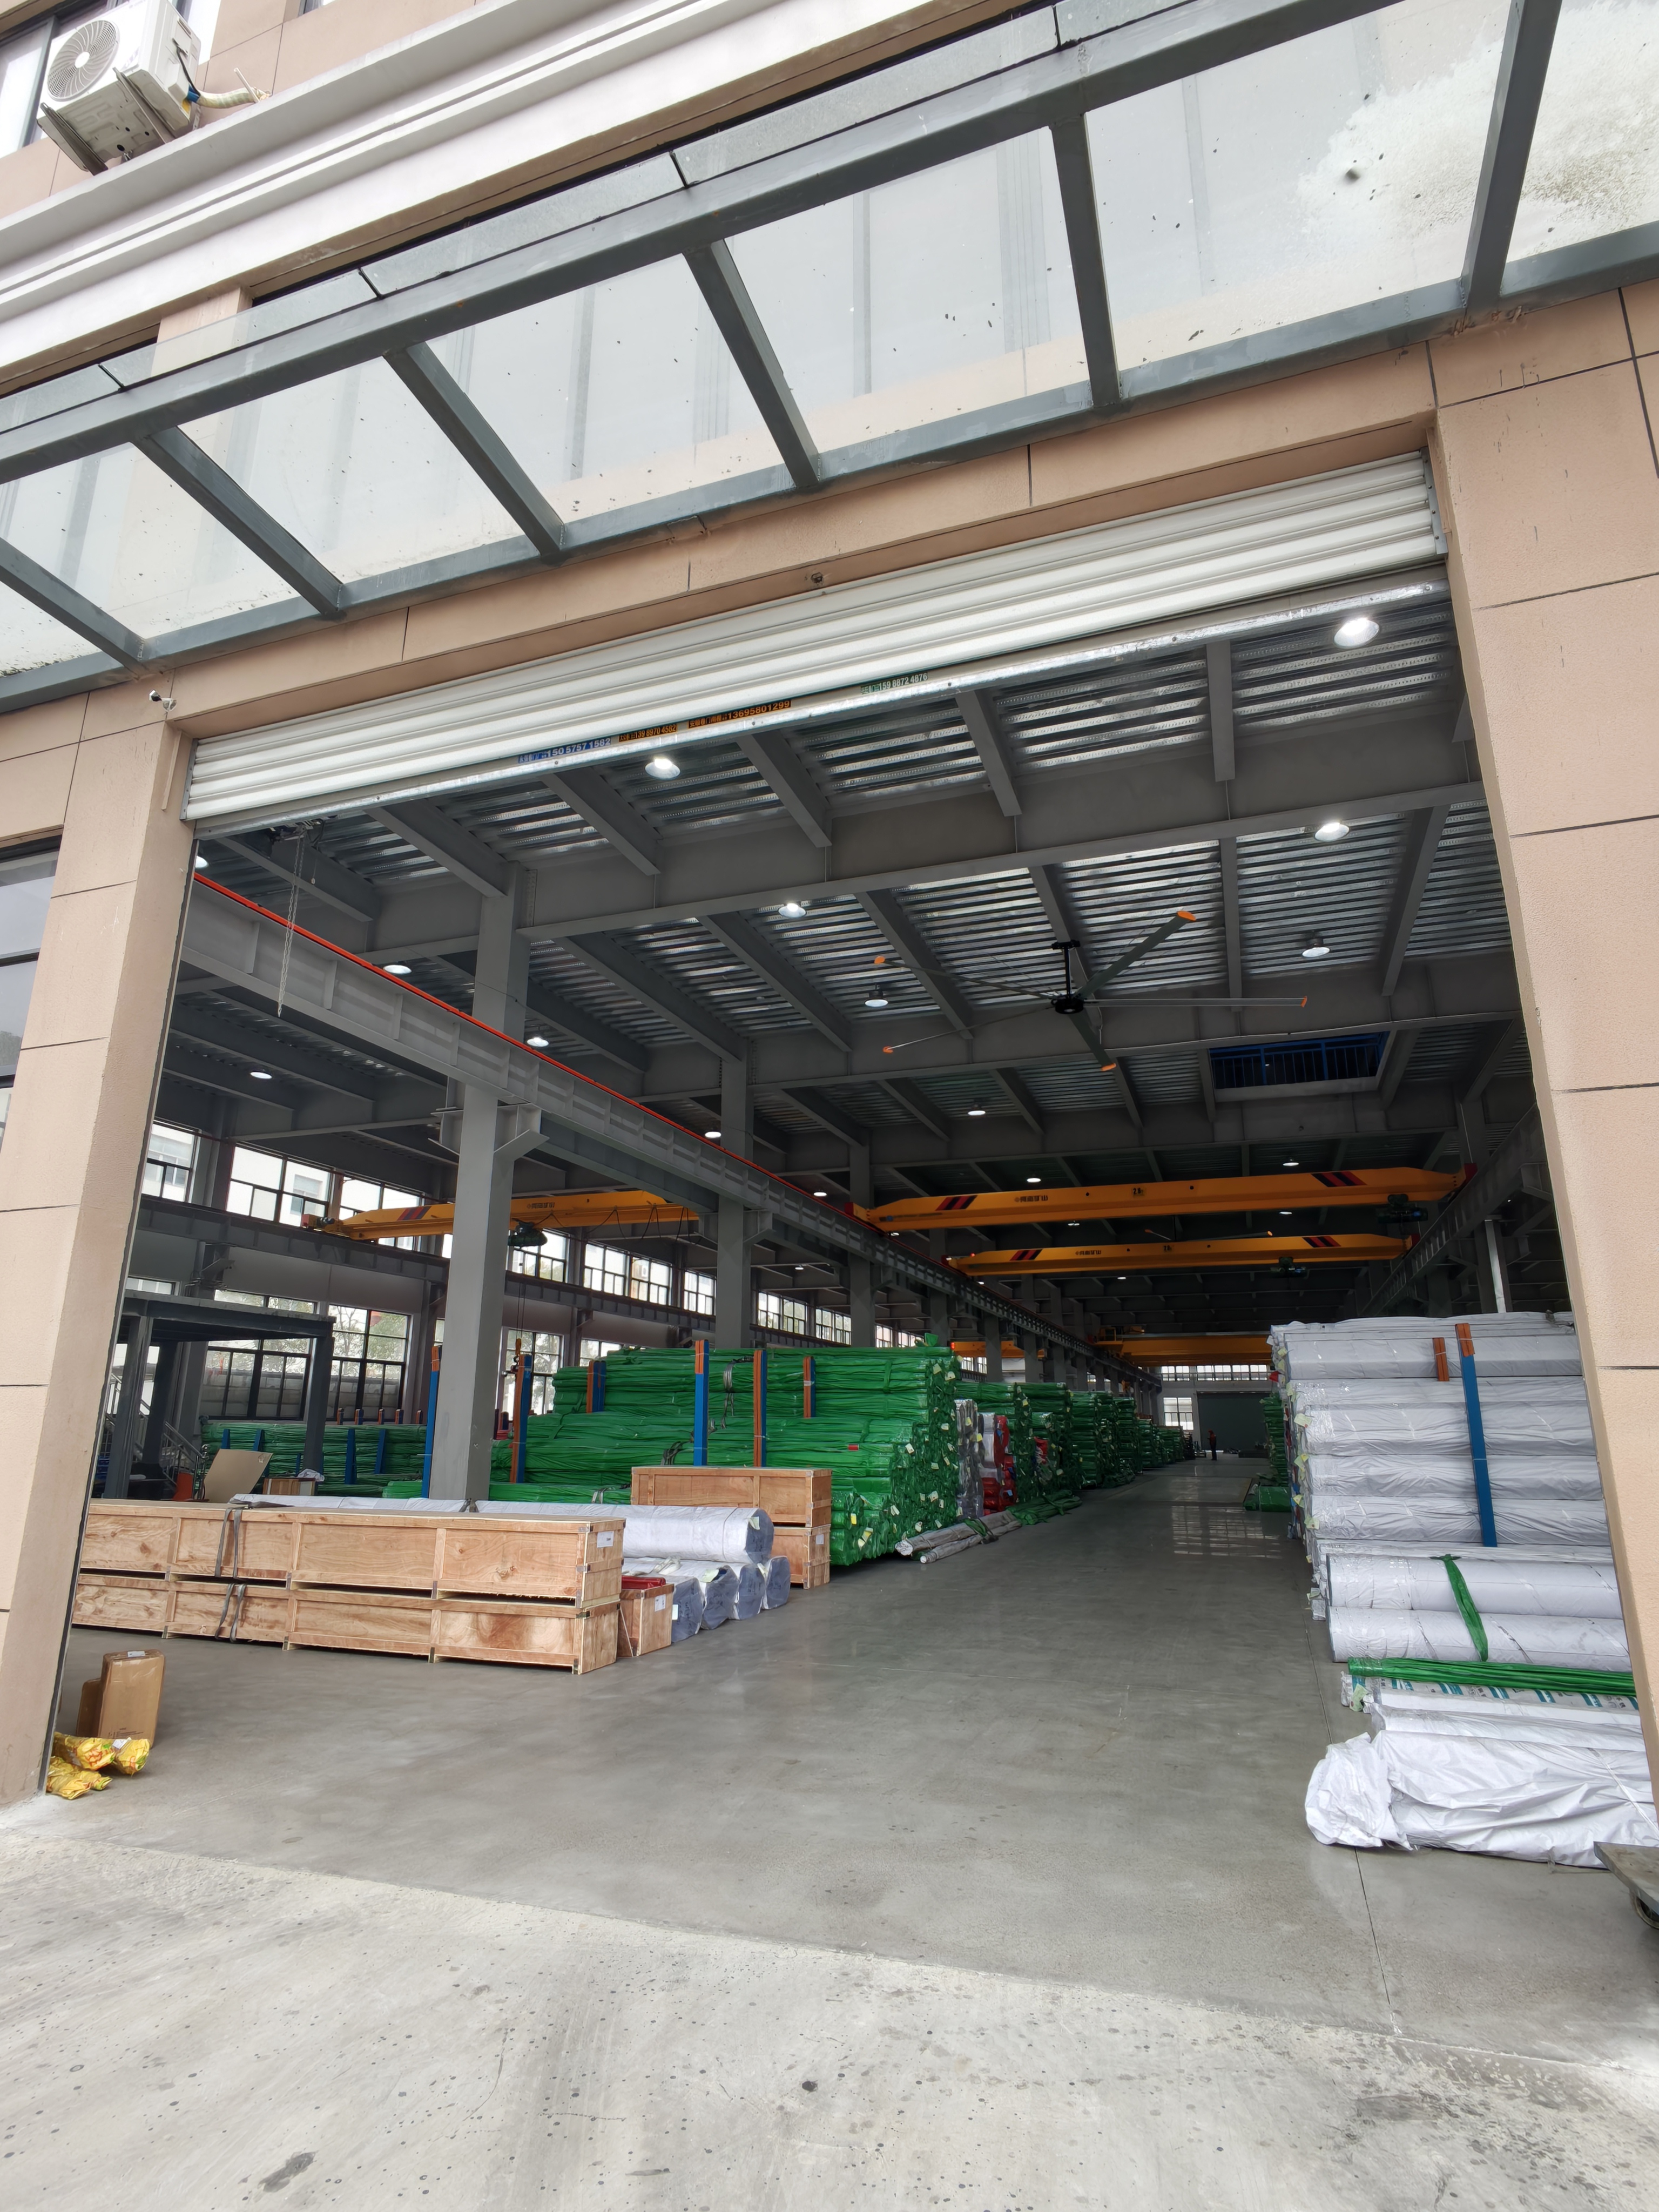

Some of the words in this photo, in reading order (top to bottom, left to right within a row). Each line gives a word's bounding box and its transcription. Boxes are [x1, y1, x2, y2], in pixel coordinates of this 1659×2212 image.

[880, 681, 891, 690] 159
[892, 677, 909, 687] 8872
[910, 673, 927, 683] 4876
[728, 700, 790, 719] 13695801299
[635, 730, 645, 738] 139
[646, 727, 660, 737] 8970
[547, 748, 564, 757] 150
[565, 743, 587, 753] 5757
[589, 738, 611, 748] 1582
